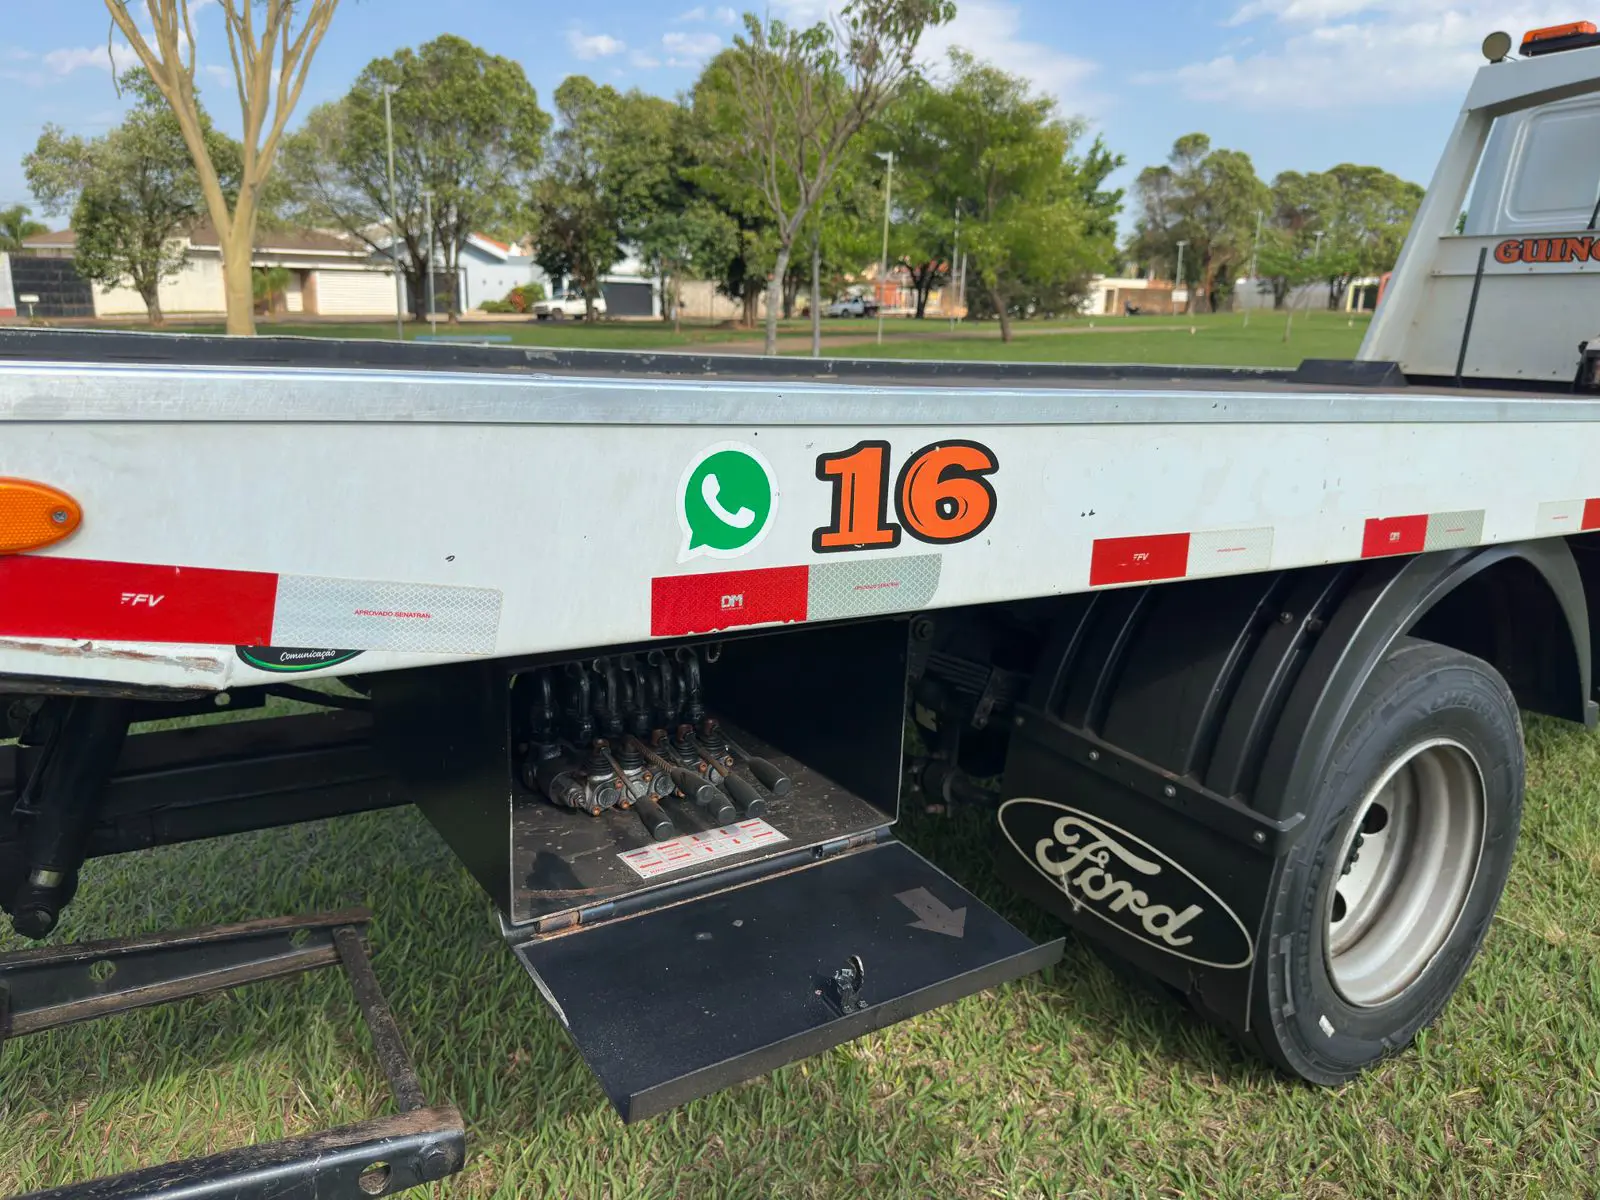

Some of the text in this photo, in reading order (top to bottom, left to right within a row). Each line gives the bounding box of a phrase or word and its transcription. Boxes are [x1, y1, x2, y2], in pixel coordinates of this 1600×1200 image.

[812, 439, 1000, 554] 16
[354, 609, 432, 619] APROVADO SENATRAN
[279, 648, 336, 662] Comunicação
[1035, 816, 1203, 947] Ford
